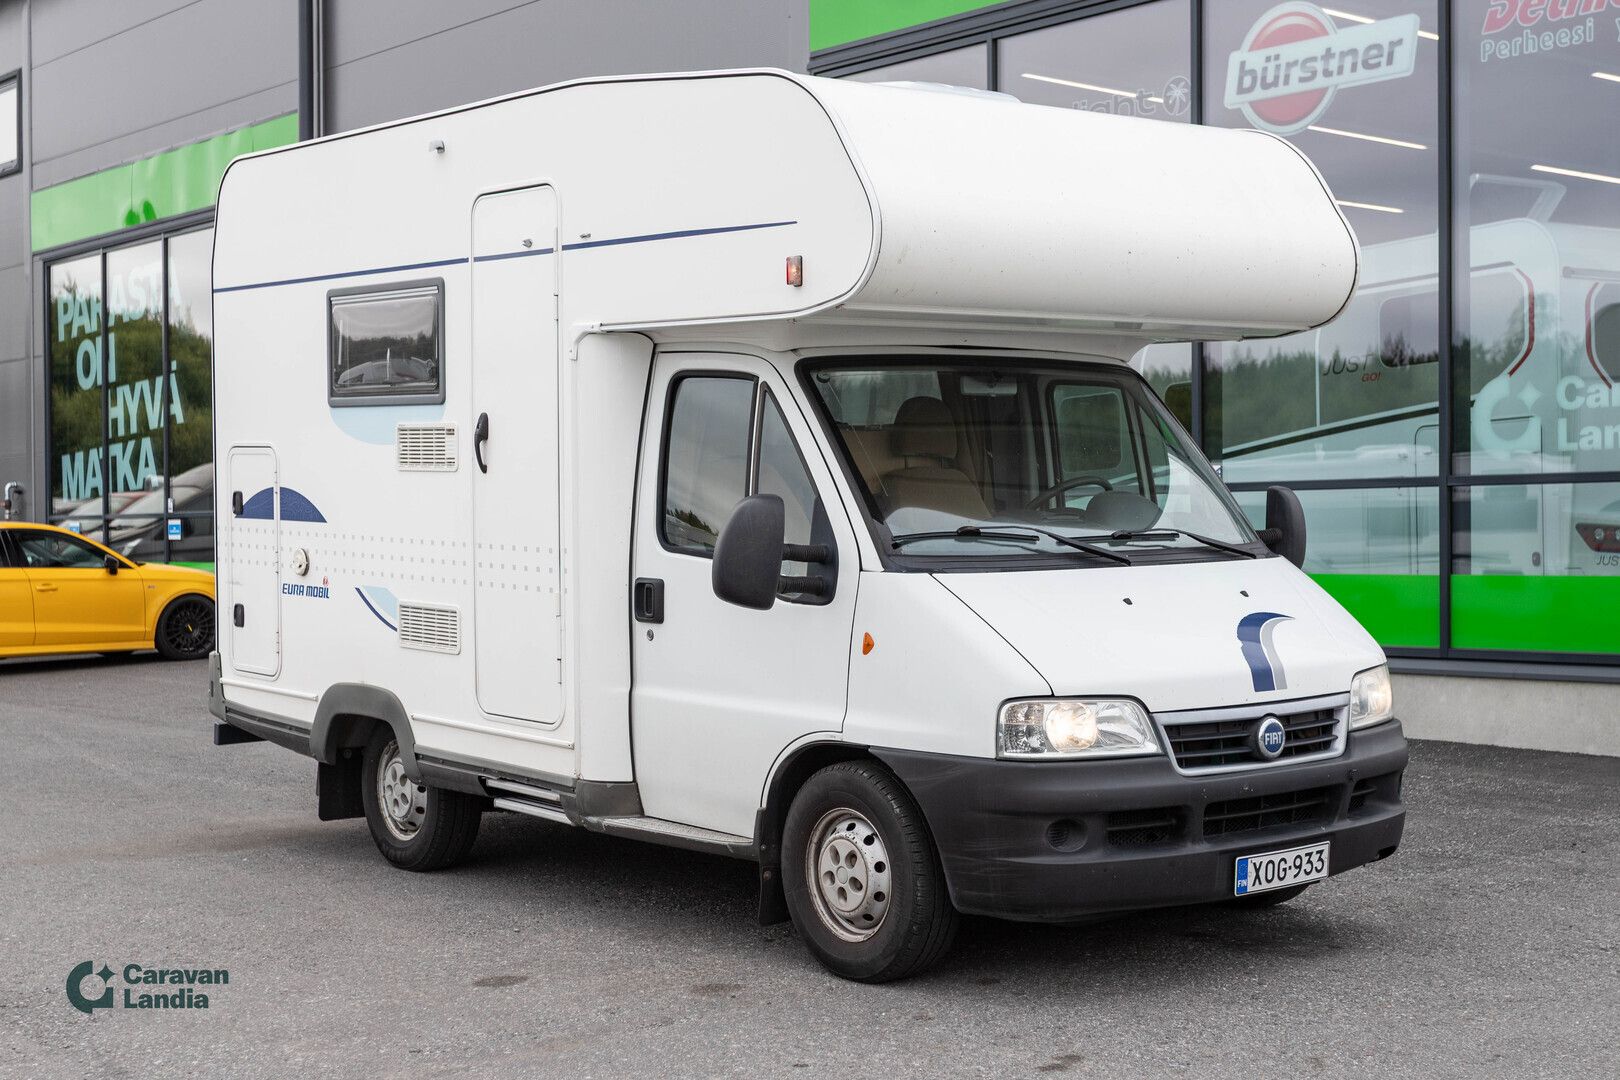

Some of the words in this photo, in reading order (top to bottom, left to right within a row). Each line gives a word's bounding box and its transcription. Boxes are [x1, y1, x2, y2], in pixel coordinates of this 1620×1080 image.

[1480, 17, 1595, 62] Perheesi
[1236, 37, 1404, 96] bürstner
[57, 256, 182, 342] PARASTA
[76, 332, 117, 391] ON
[1322, 353, 1375, 376] JUST
[107, 360, 185, 439] HYVÄ
[61, 436, 160, 504] MATKA
[282, 583, 305, 596] EURA
[306, 585, 330, 599] MOBIL
[1264, 731, 1282, 746] FIAT
[1251, 849, 1325, 887] XOG-933
